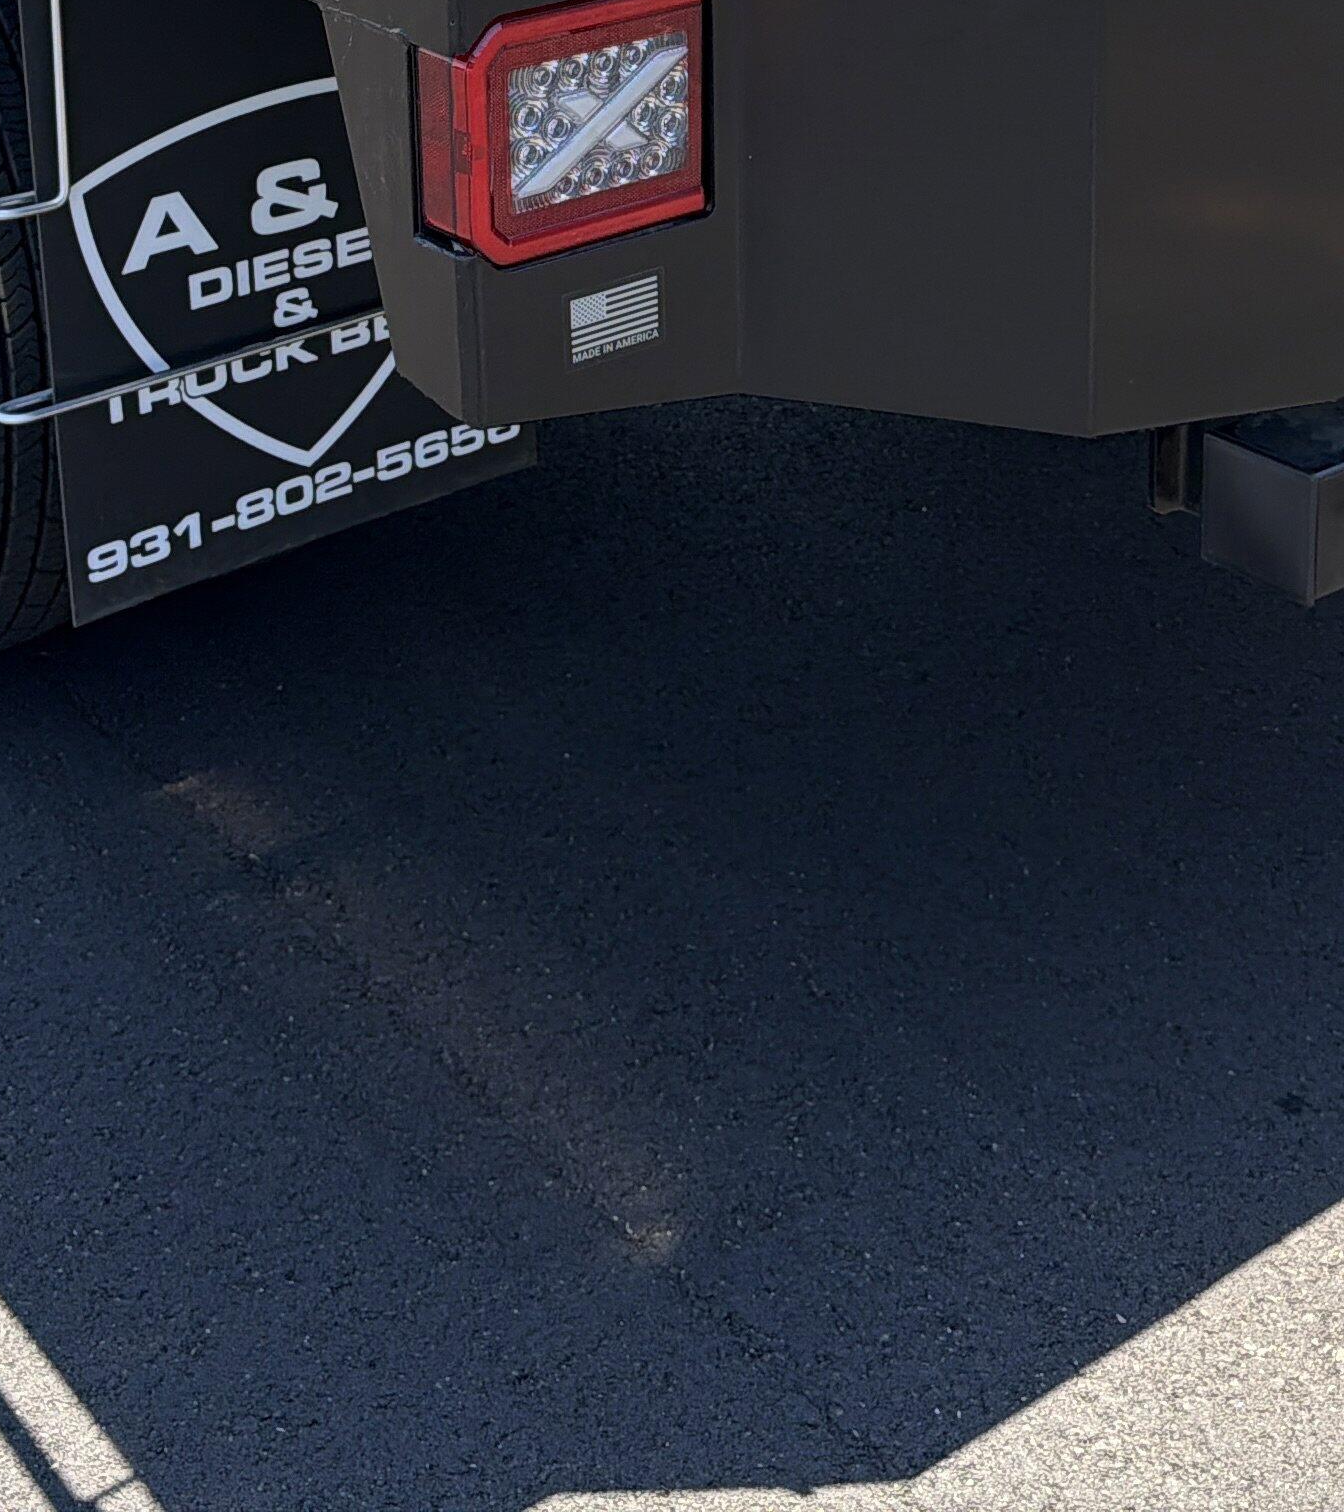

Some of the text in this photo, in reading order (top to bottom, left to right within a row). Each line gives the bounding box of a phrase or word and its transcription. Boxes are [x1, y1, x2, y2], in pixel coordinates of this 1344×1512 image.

[120, 157, 339, 276] A &
[188, 226, 373, 311] DIESE
[273, 287, 319, 328] &
[572, 329, 660, 364] MADE IN AMERICA
